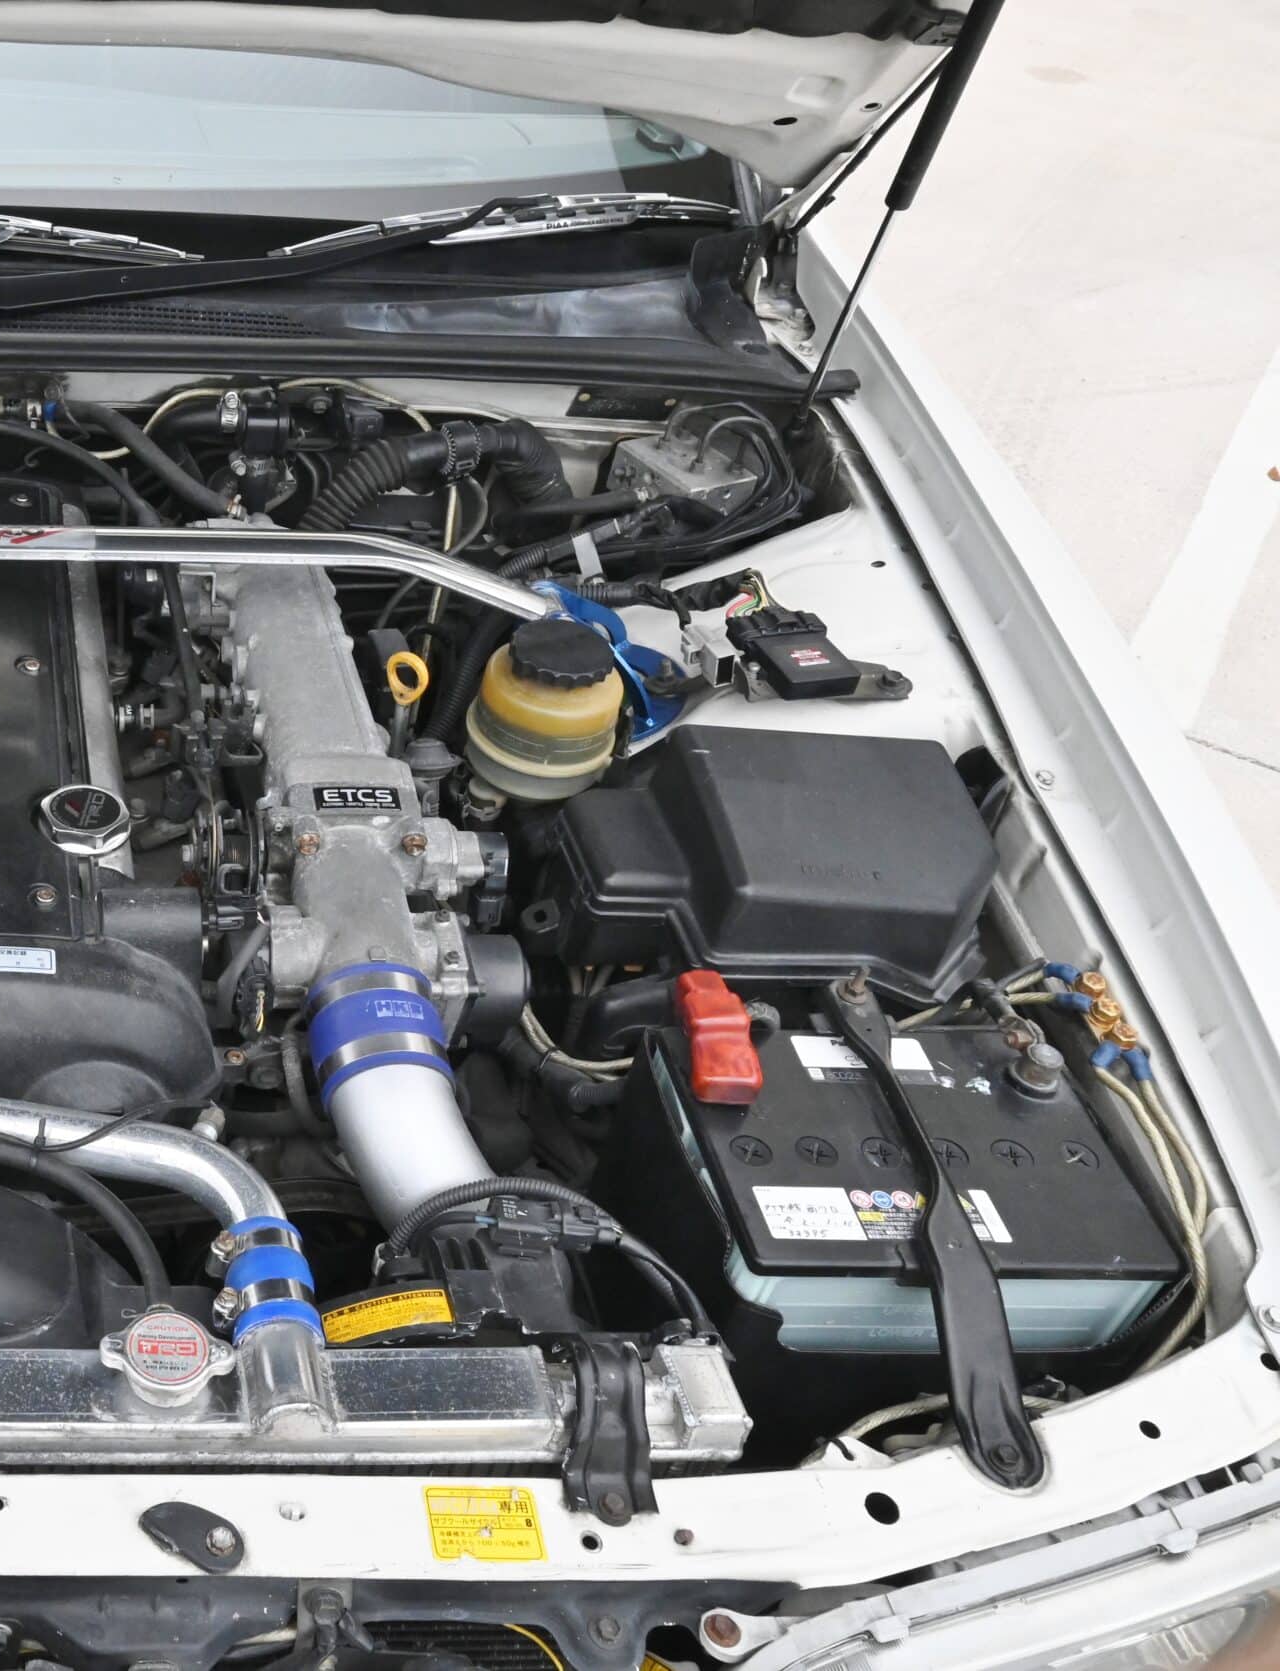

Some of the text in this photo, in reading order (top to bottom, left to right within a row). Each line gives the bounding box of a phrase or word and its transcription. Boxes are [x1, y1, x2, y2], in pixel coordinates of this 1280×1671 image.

[322, 788, 393, 803] ETCS
[138, 1340, 198, 1357] TRD
[499, 1500, 529, 1514] 専用
